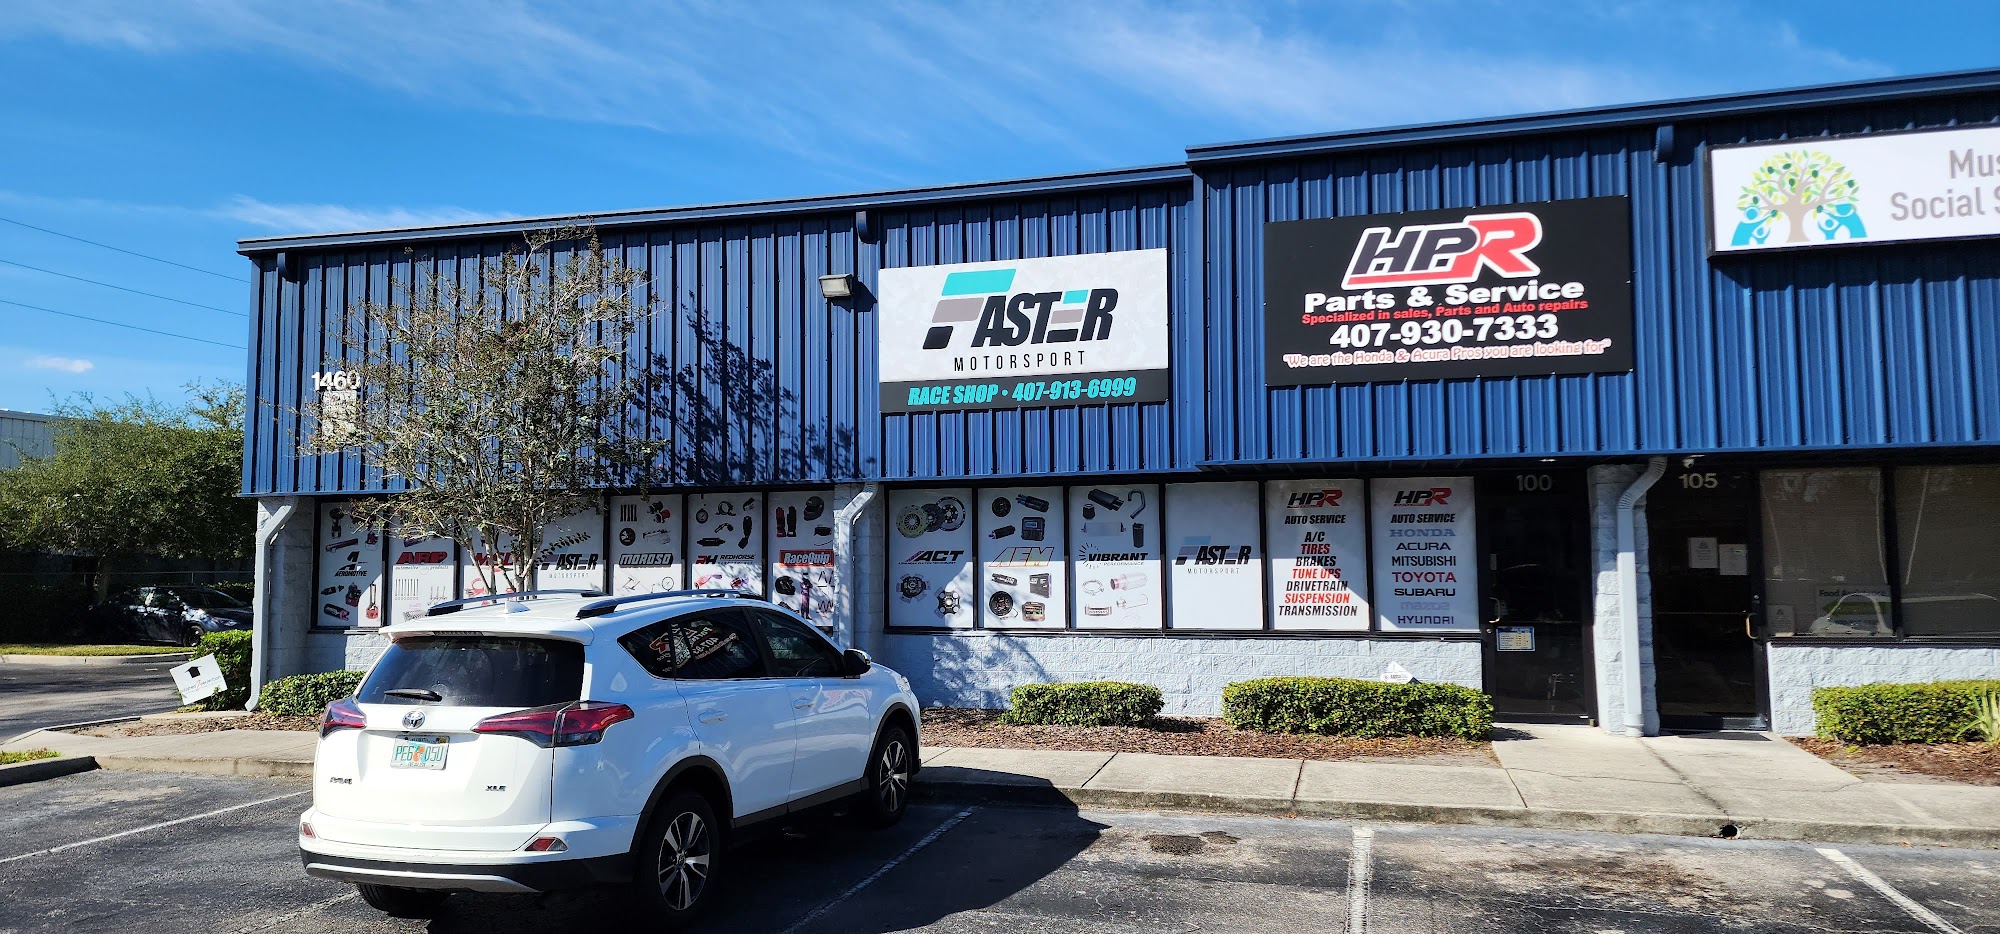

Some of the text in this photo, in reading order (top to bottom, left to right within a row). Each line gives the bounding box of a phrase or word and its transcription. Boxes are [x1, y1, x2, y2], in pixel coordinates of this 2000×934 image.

[1891, 187, 1986, 221] Social
[1341, 212, 1543, 290] HPR
[1304, 279, 1585, 313] Parts & Service
[922, 268, 1118, 349] FASTER
[1302, 299, 1589, 326] Specialized in sales, Parts and Auto repairs
[1329, 313, 1559, 348] 407-930-7333
[1309, 354, 1331, 367] are
[1331, 351, 1352, 365] the
[1353, 349, 1394, 364] Honda
[1395, 347, 1410, 362] &
[1411, 347, 1450, 361] Acura
[1451, 345, 1483, 360] Pros
[1483, 346, 1509, 359] you
[1510, 344, 1533, 357] are
[1534, 340, 1583, 356] looking
[954, 350, 1085, 372] MOTORSPORT
[311, 370, 361, 391] 1460
[908, 376, 1137, 406] RACE SHOP 407-913-6999
[1516, 474, 1552, 491] 100
[1678, 473, 1718, 489] 105
[1287, 489, 1343, 508] HPR
[1393, 487, 1452, 507] HPR
[1284, 514, 1347, 525] AUTO SERVICE
[1390, 513, 1456, 524] AUTO SERVICE
[1304, 531, 1325, 542] A/C
[1389, 528, 1456, 538] HONDA
[1301, 543, 1331, 555] TIRES
[1395, 542, 1451, 551] ACURA
[395, 551, 448, 564] ARP
[783, 552, 831, 565] RaceQuip
[907, 550, 965, 562] ACT
[988, 546, 1055, 567] AEM
[1088, 552, 1149, 562] VIBRANT
[1295, 556, 1337, 567] BRAKES
[1391, 555, 1457, 567] MITSUBISHI
[1187, 567, 1240, 575] MOTORSPORT
[1292, 568, 1341, 579] TUNE UPS
[1391, 571, 1457, 583] TOYOTA
[1286, 580, 1348, 592] DRIVETRAIN
[1284, 593, 1350, 604] SUSPENSION
[1394, 588, 1456, 597] SUBARU
[1278, 605, 1358, 616] TRANSMISSION
[1397, 615, 1454, 624] HYUNDAI
